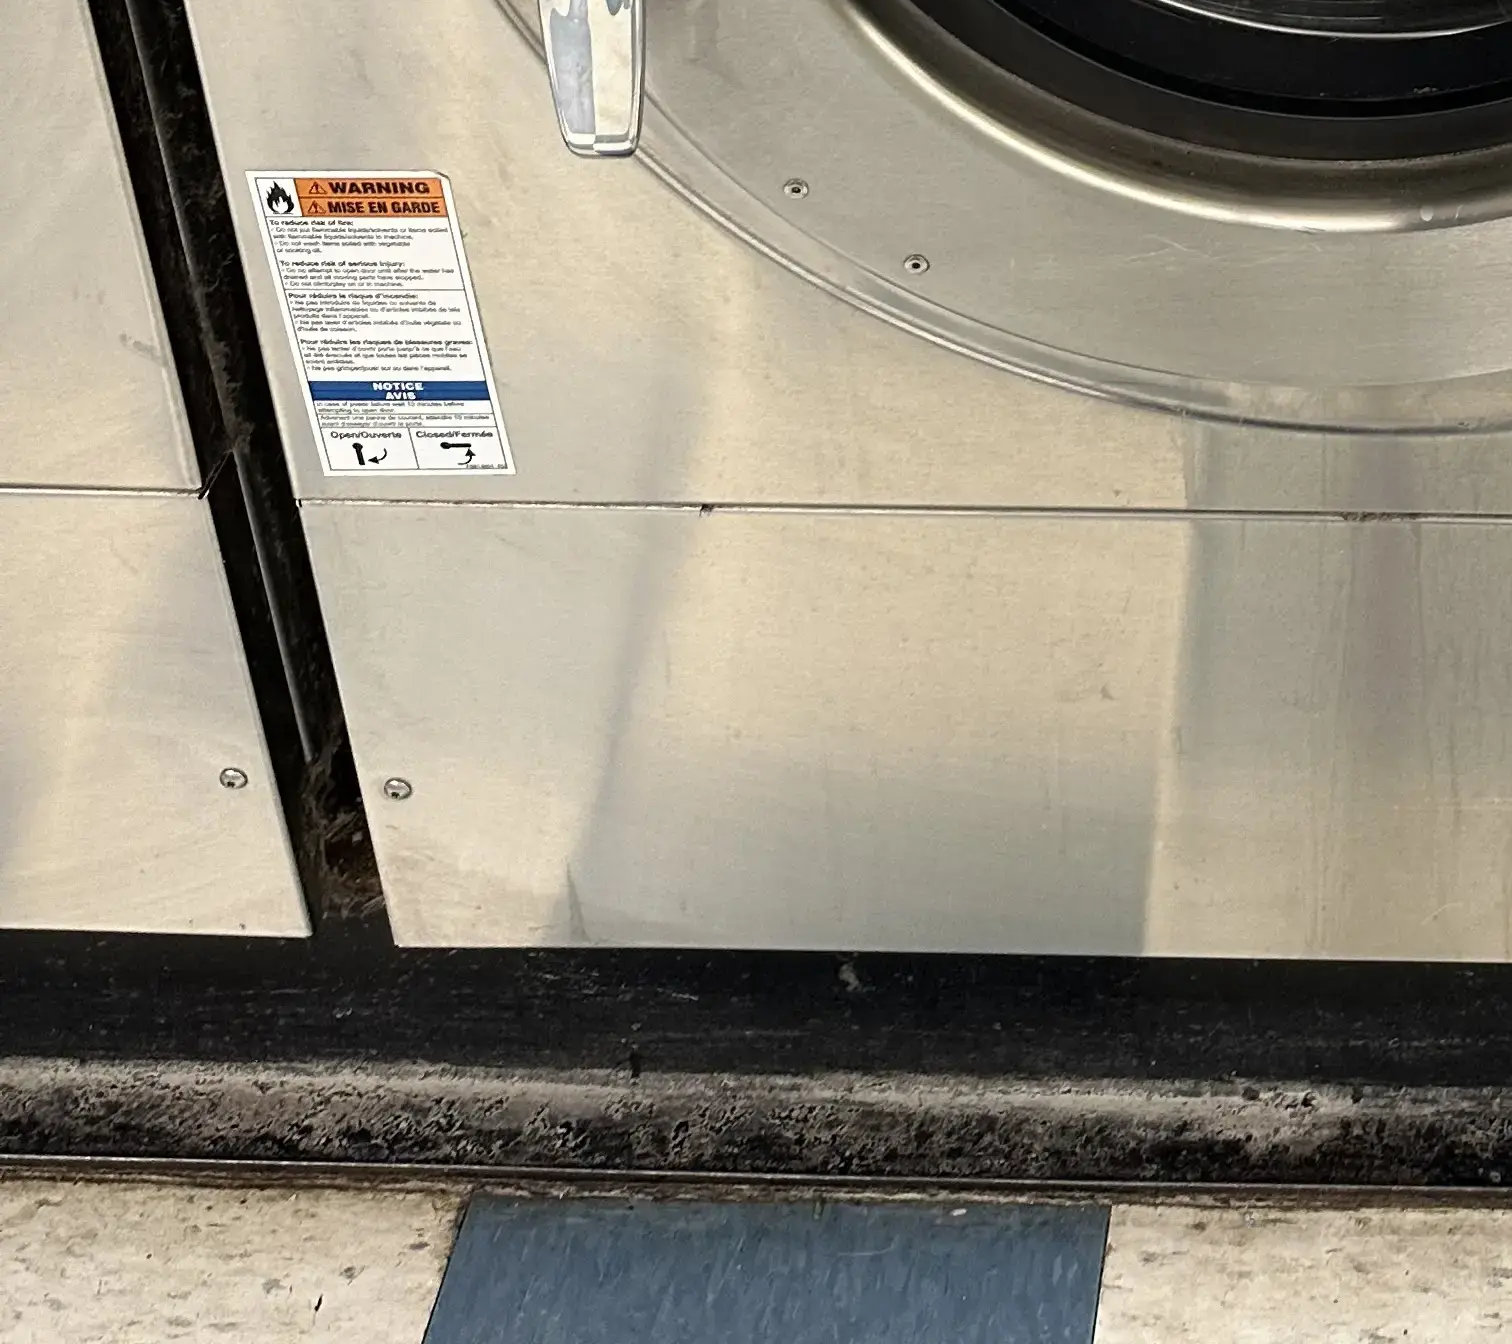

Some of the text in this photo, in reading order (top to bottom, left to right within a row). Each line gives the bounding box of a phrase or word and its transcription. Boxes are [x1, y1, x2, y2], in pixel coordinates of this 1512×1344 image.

[329, 182, 429, 194] WARNING
[328, 201, 440, 213] MISE EN GARDE
[373, 382, 424, 390] NOTICE
[385, 392, 416, 400] AVIS
